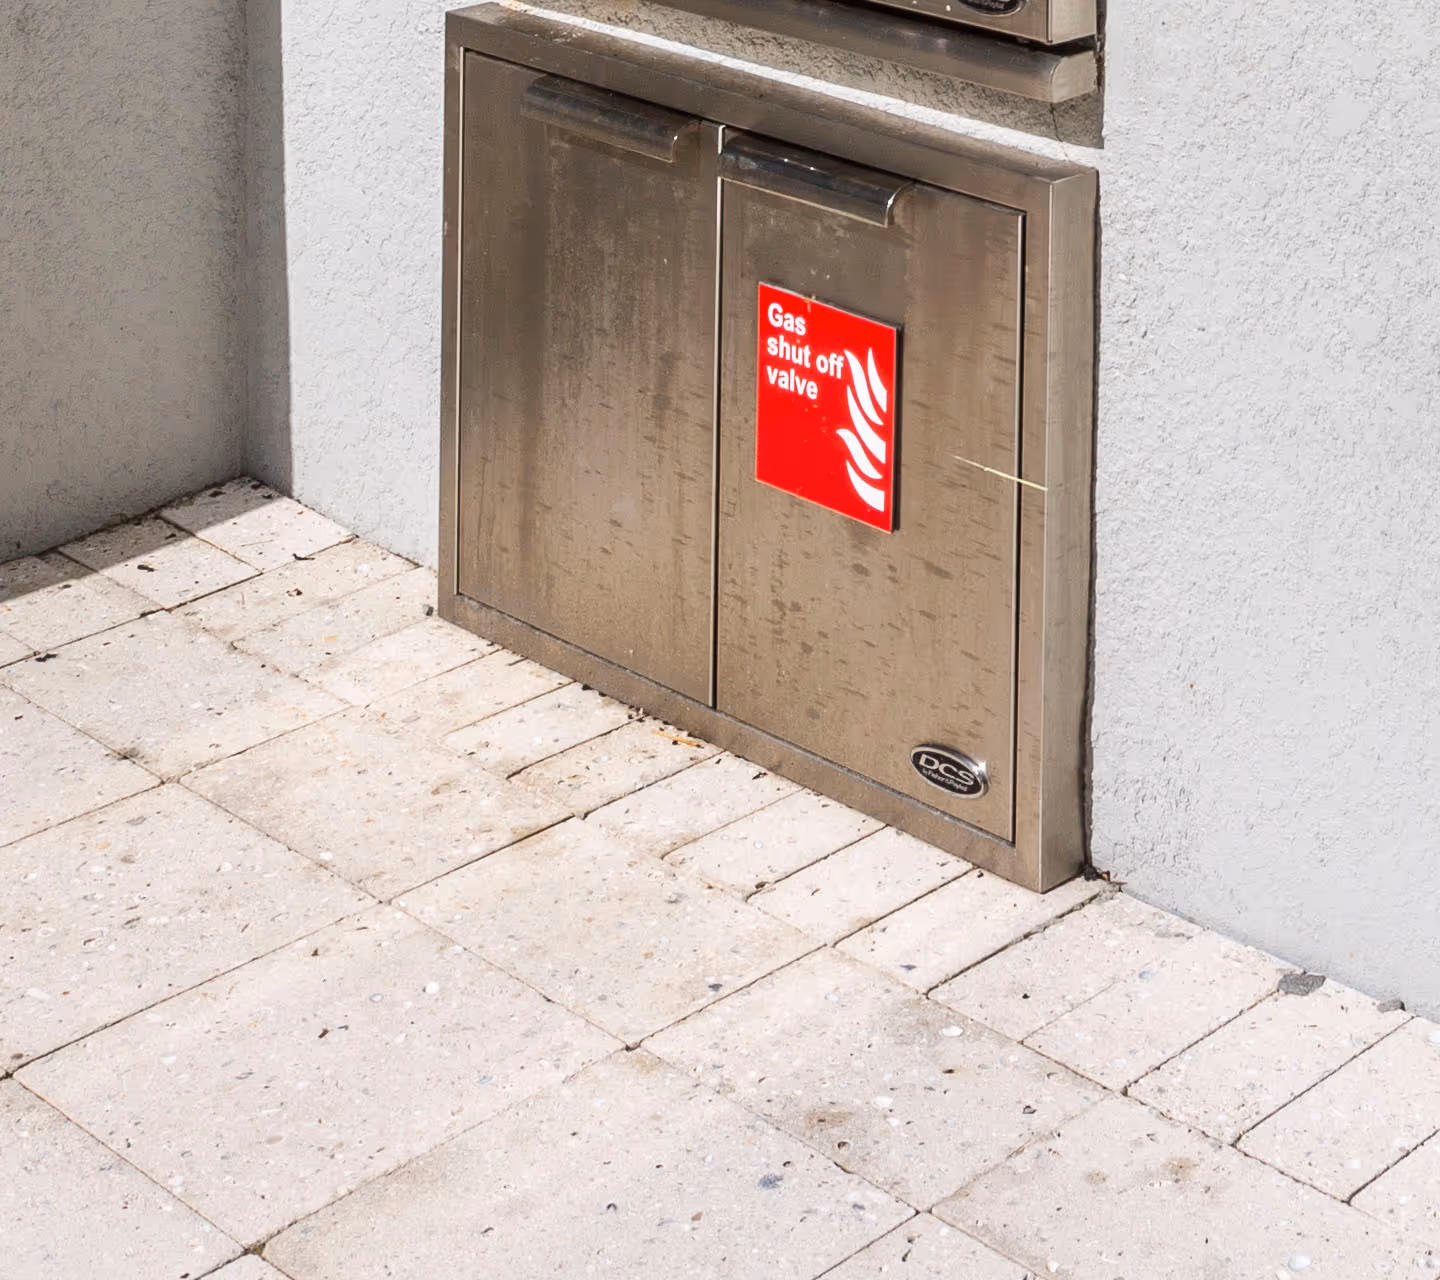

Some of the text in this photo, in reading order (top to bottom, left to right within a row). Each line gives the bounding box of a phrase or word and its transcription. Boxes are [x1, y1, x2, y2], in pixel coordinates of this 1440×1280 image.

[767, 302, 806, 336] Gas
[767, 336, 844, 379] shut off
[767, 365, 818, 400] valve
[919, 754, 974, 786] DCS
